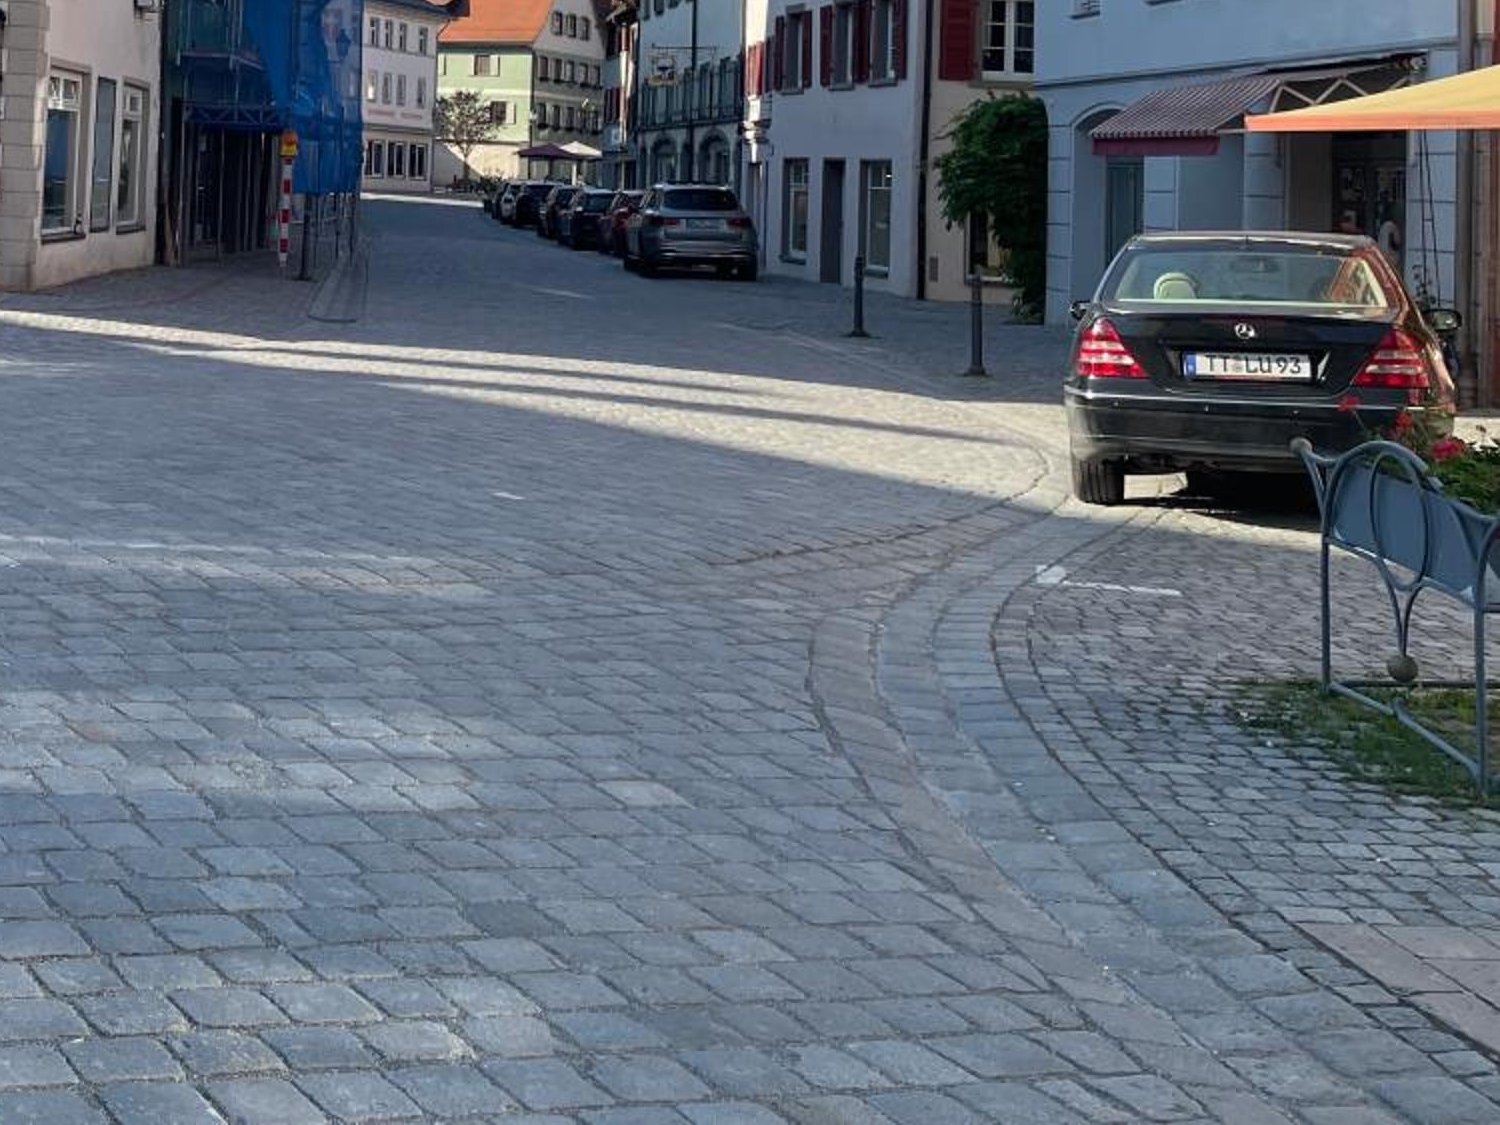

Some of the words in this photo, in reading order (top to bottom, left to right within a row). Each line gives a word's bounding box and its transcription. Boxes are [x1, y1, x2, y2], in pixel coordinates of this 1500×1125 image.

[1205, 355, 1229, 372] TT
[1245, 356, 1271, 373] LU
[1275, 357, 1301, 374] 93
